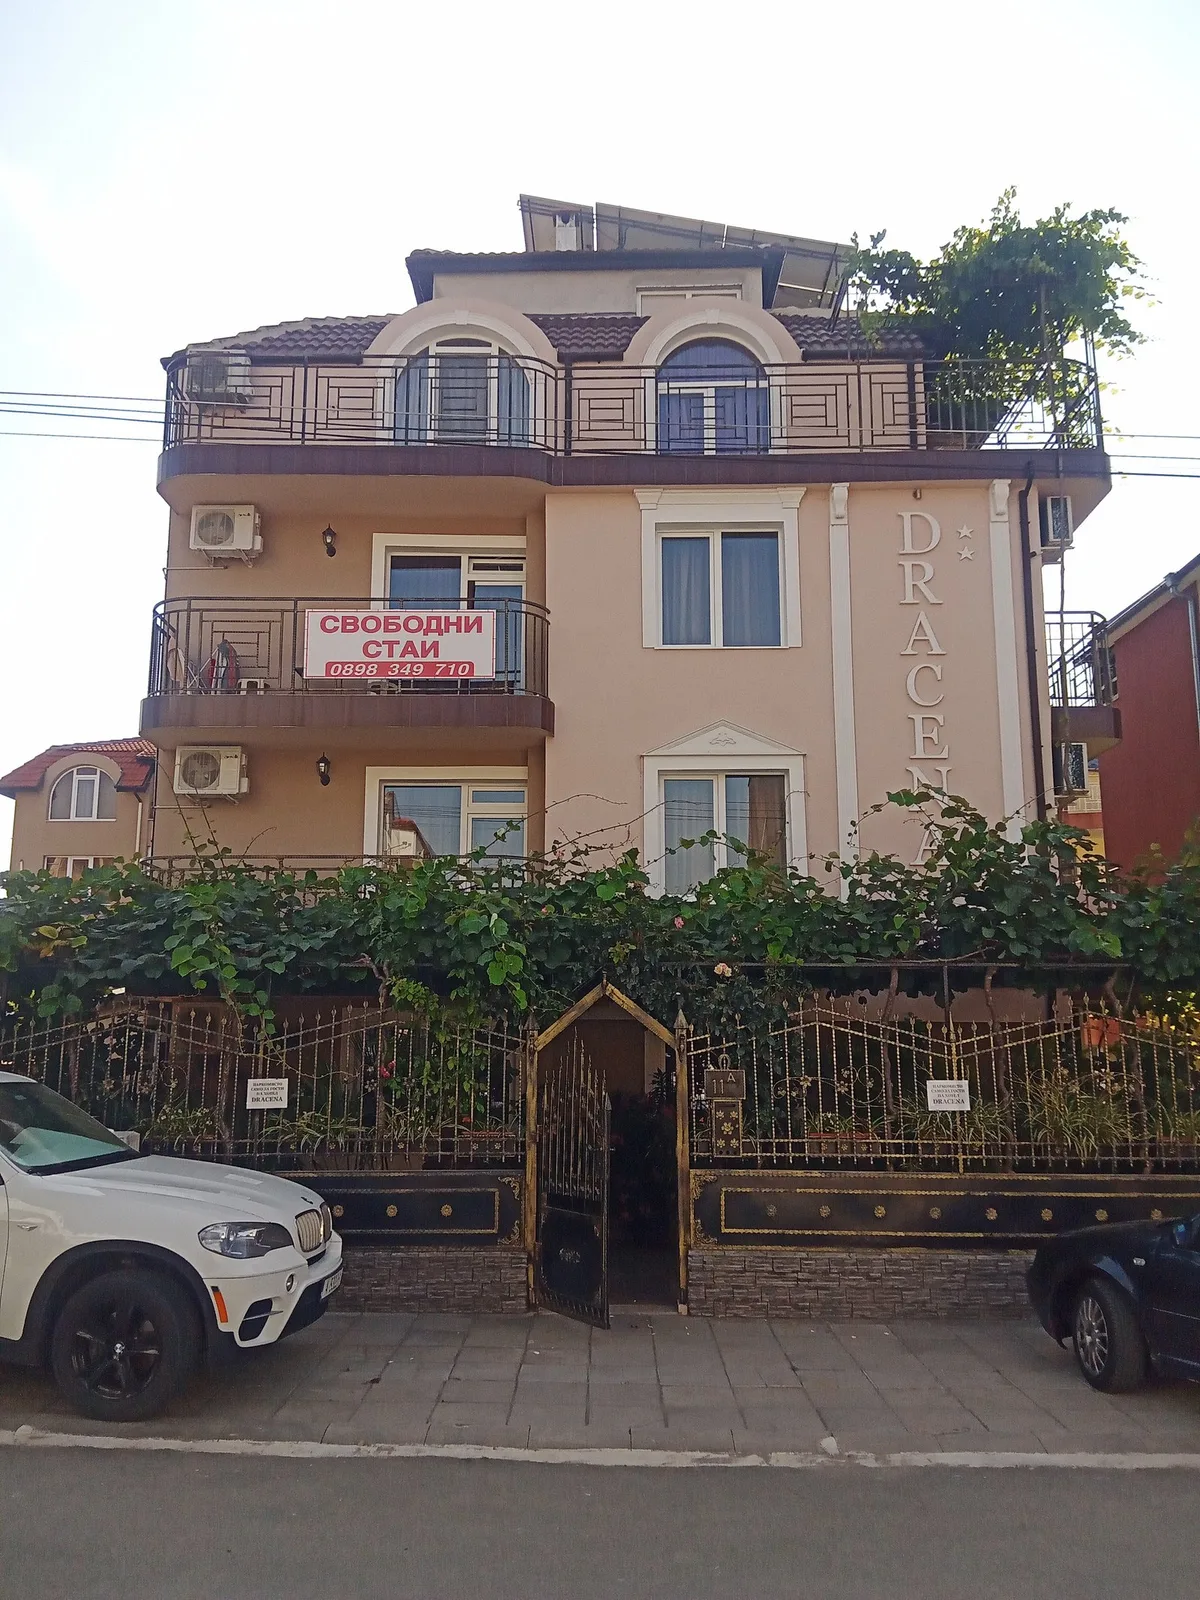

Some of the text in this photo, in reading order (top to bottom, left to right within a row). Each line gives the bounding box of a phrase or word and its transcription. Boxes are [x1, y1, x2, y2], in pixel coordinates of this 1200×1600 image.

[319, 615, 483, 636] СВОБОДНИ
[362, 640, 440, 658] СТАИ
[329, 663, 470, 676] 0898 349 710
[897, 511, 952, 867] DRACENA
